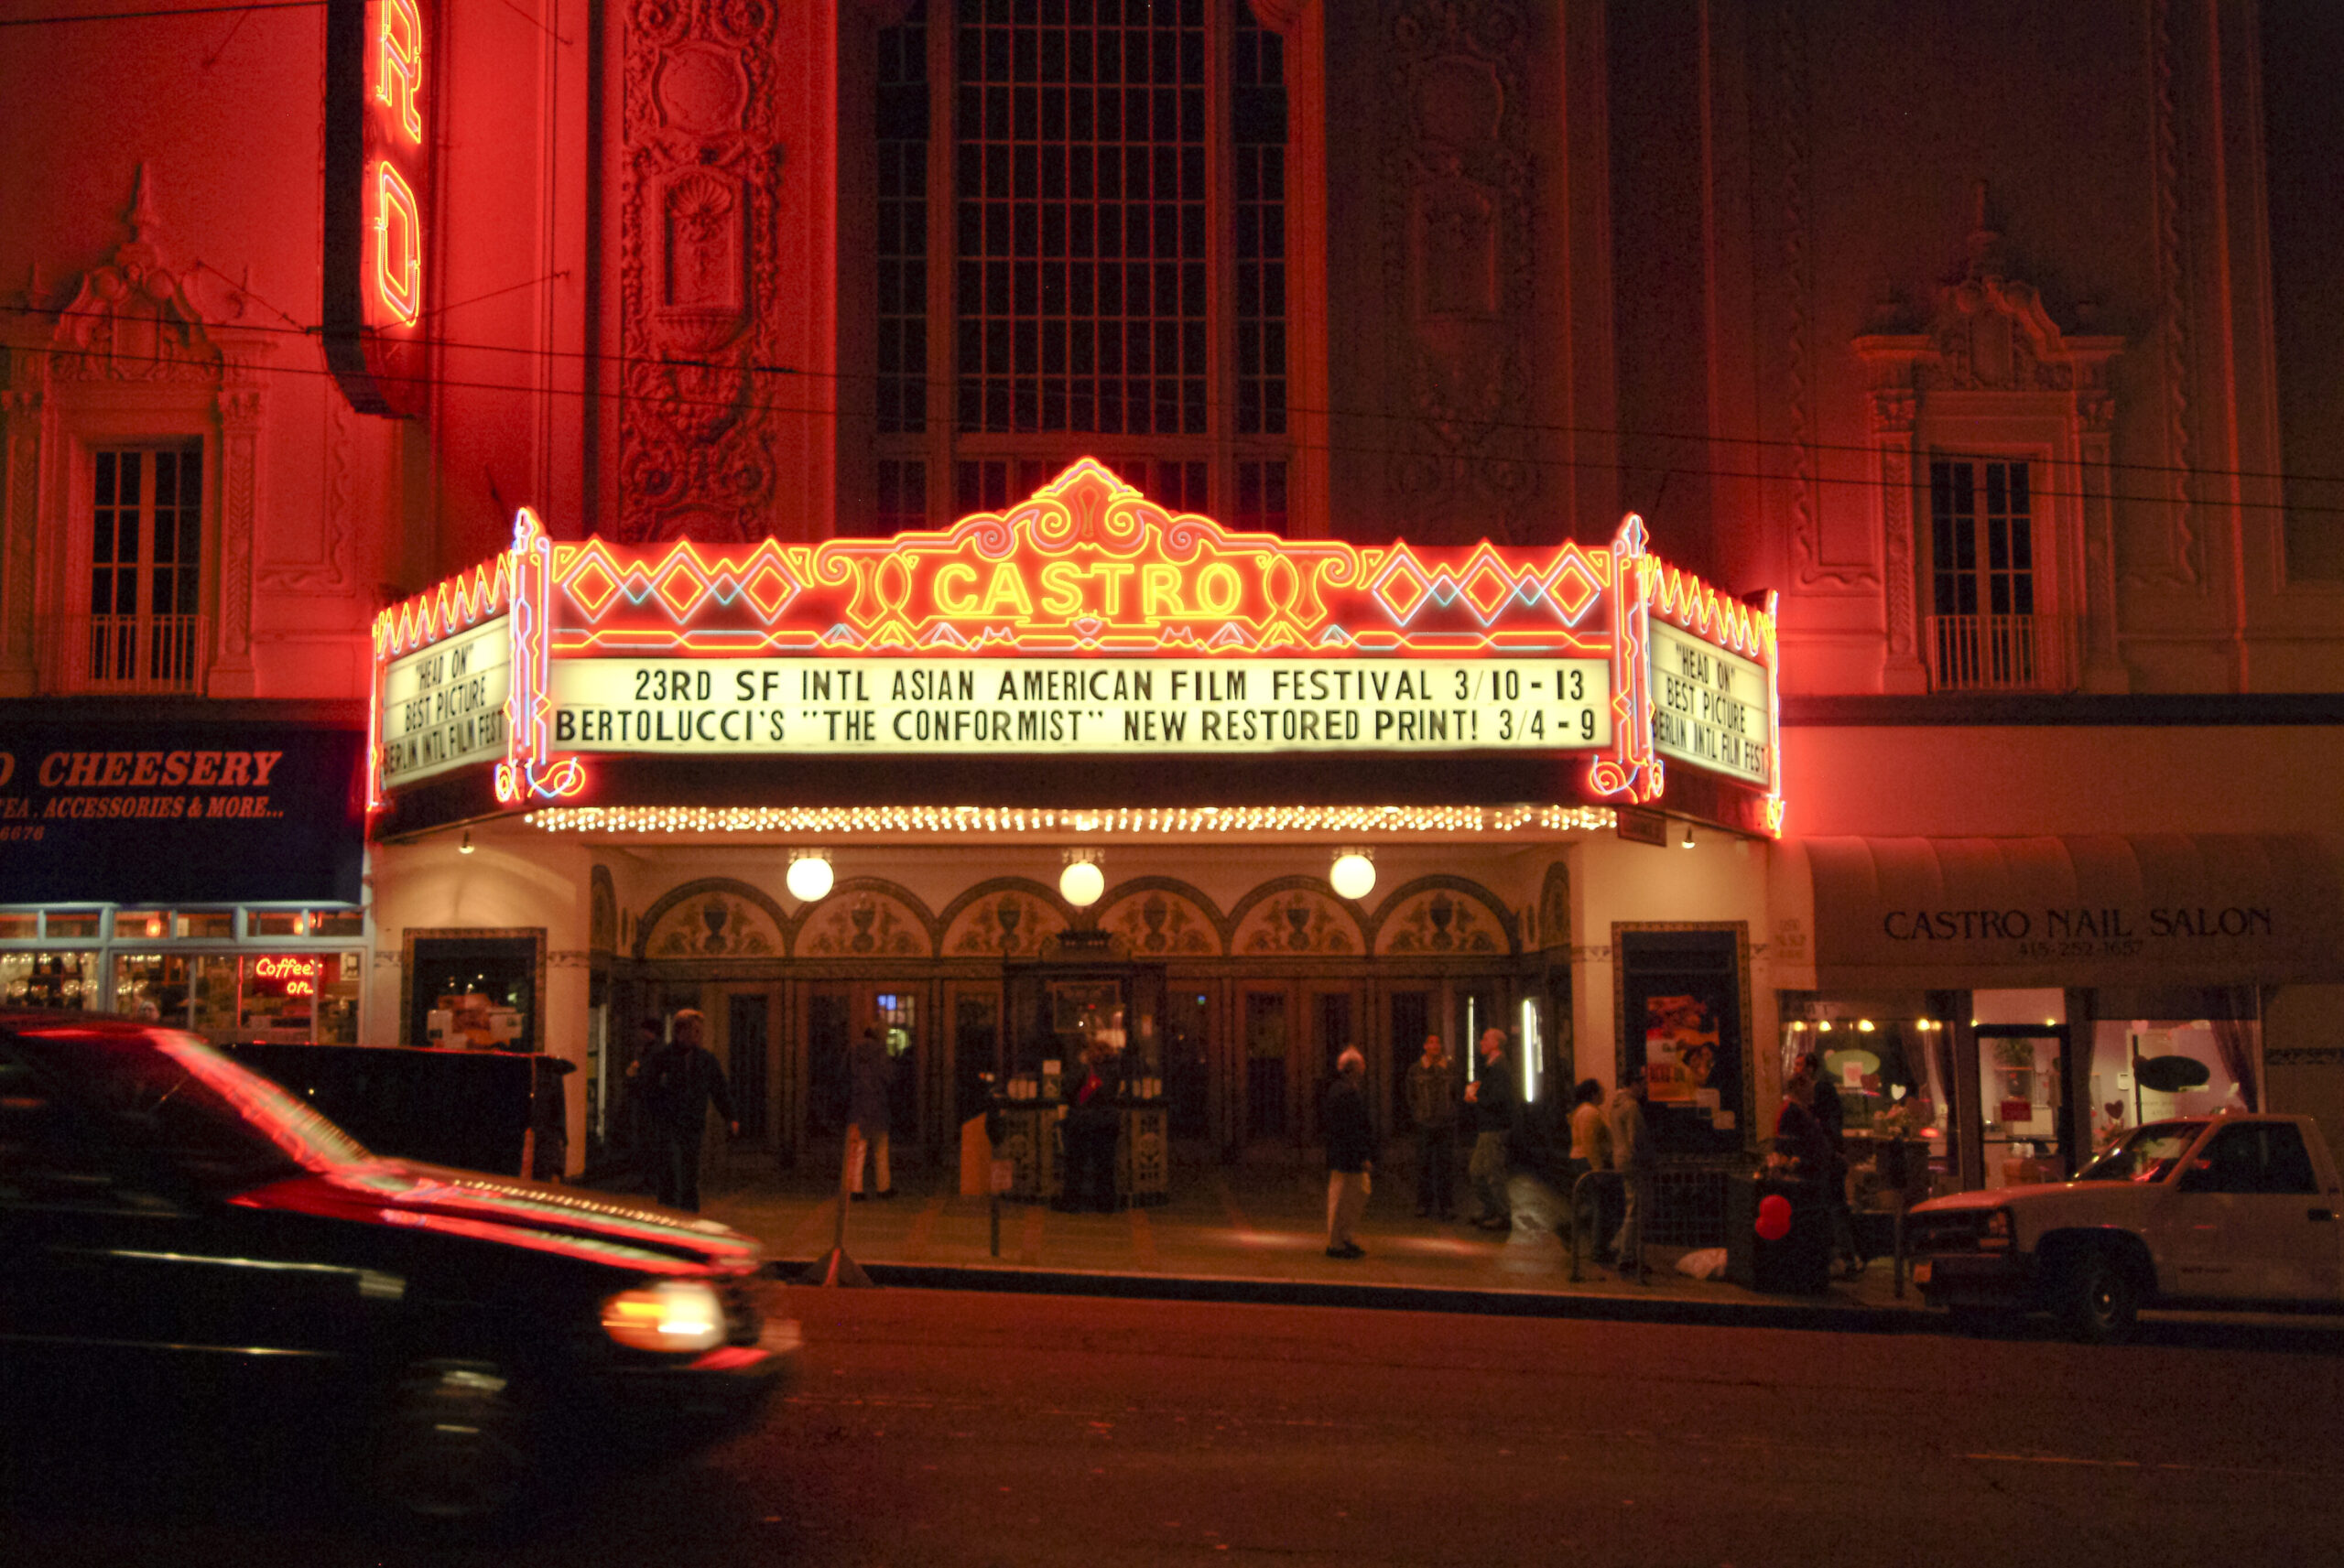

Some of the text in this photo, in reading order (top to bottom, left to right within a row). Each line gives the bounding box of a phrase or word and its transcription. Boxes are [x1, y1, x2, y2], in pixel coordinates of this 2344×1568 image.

[933, 561, 1243, 617] CASTRO
[635, 669, 711, 701] 23RD
[736, 669, 779, 701] SF
[802, 669, 869, 701] INTL
[892, 669, 974, 701] ASIAN
[998, 669, 1153, 701] AMERICAN
[1171, 669, 1246, 701] FILM
[1272, 669, 1433, 701] FESTIVAL
[405, 676, 486, 732] BEST PICTURE
[1666, 676, 1746, 734] BEST PICTURE
[555, 709, 785, 741] BERTOLUCCI'S
[1124, 709, 1187, 741] NEW
[1201, 709, 1361, 741] RESTORED
[1374, 709, 1478, 741] PRINT!
[1654, 709, 1765, 773] BERLIN INTL FILM FEST
[383, 736, 418, 777] BERLIN
[449, 718, 475, 757] FILM
[478, 711, 505, 747] FEST
[38, 751, 283, 788] CHEESERY
[43, 795, 185, 819] ACCESSORIES
[187, 796, 203, 819] &
[206, 795, 285, 819] MORE...
[1883, 907, 2273, 941] CASTRO NAIL SALON
[286, 980, 315, 995] on
